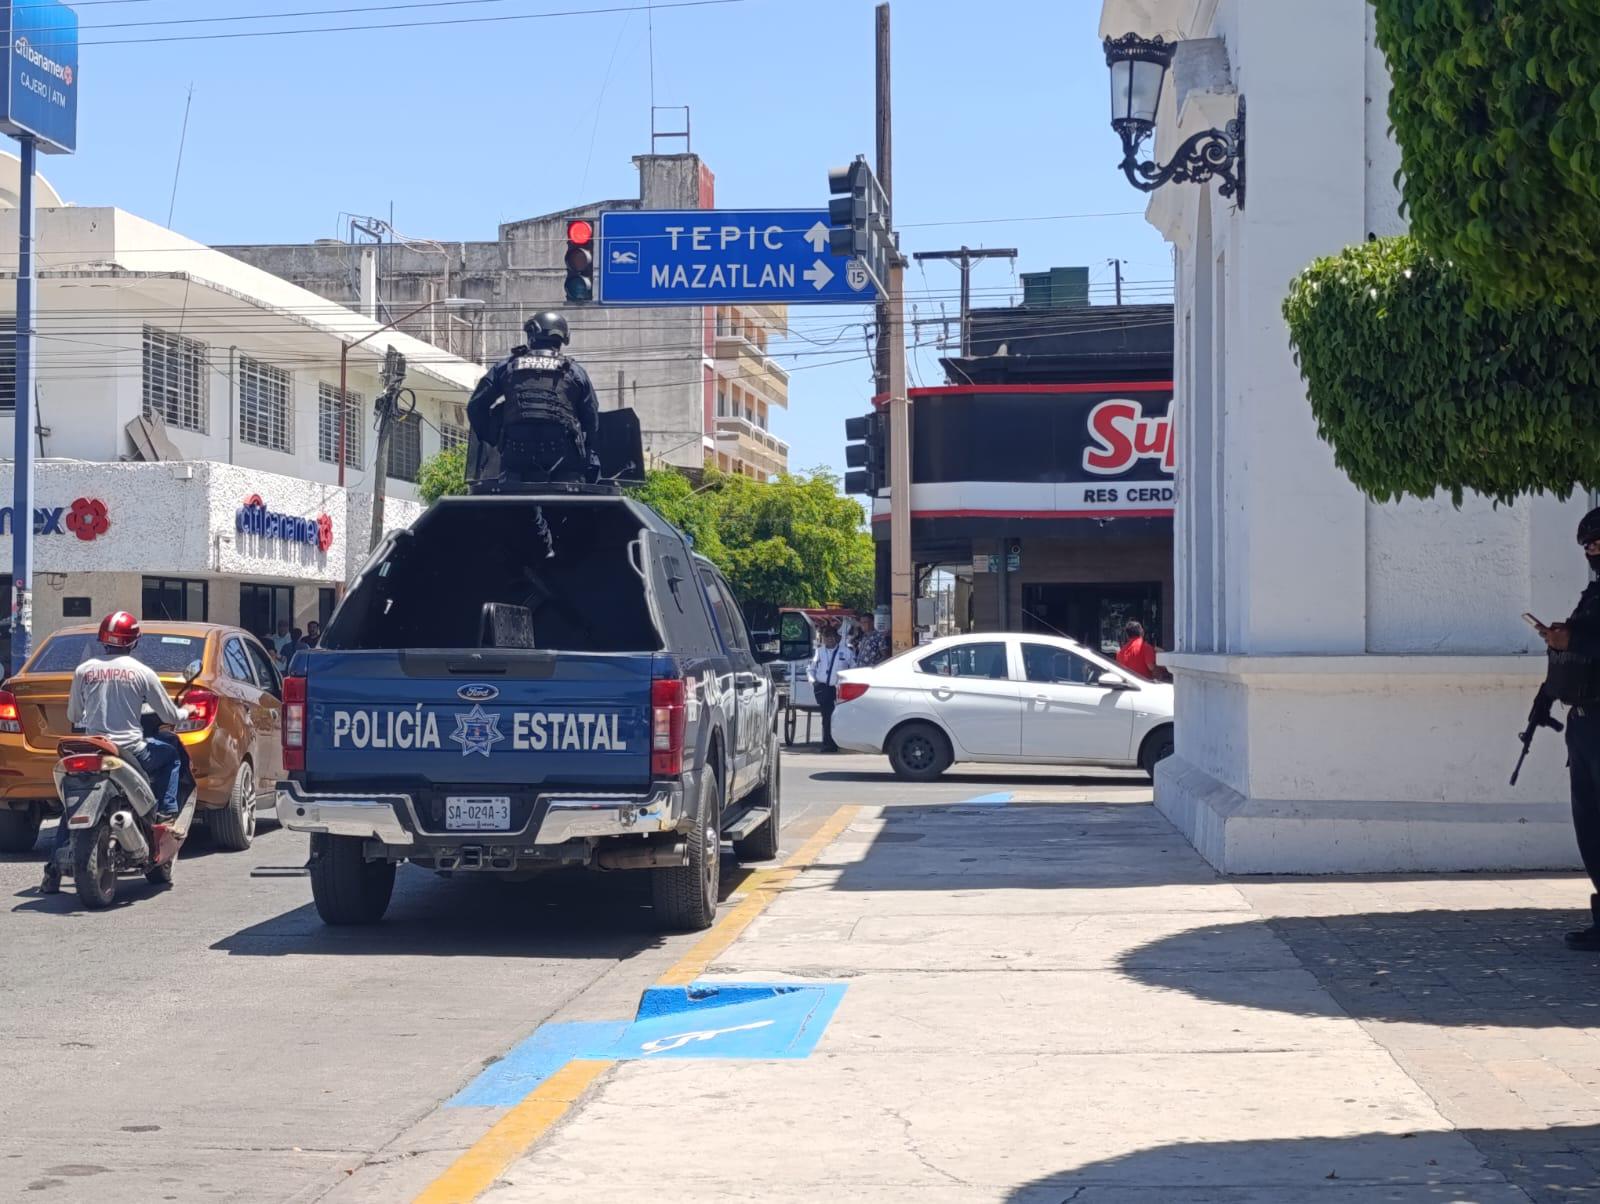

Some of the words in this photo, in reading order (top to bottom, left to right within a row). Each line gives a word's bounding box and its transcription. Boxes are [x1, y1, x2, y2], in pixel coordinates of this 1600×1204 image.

[15, 38, 65, 80] citibanamex
[20, 72, 48, 98] CAJERO
[52, 91, 66, 108] ATM
[665, 226, 784, 250] TEPIC
[651, 264, 795, 289] MAZATLAN
[852, 271, 865, 284] 15
[1084, 489, 1118, 503] RES
[1126, 488, 1173, 502] CERD
[333, 702, 441, 749] POLICÍA
[512, 712, 627, 751] ESTATAL
[448, 806, 508, 819] SA-024A-3
